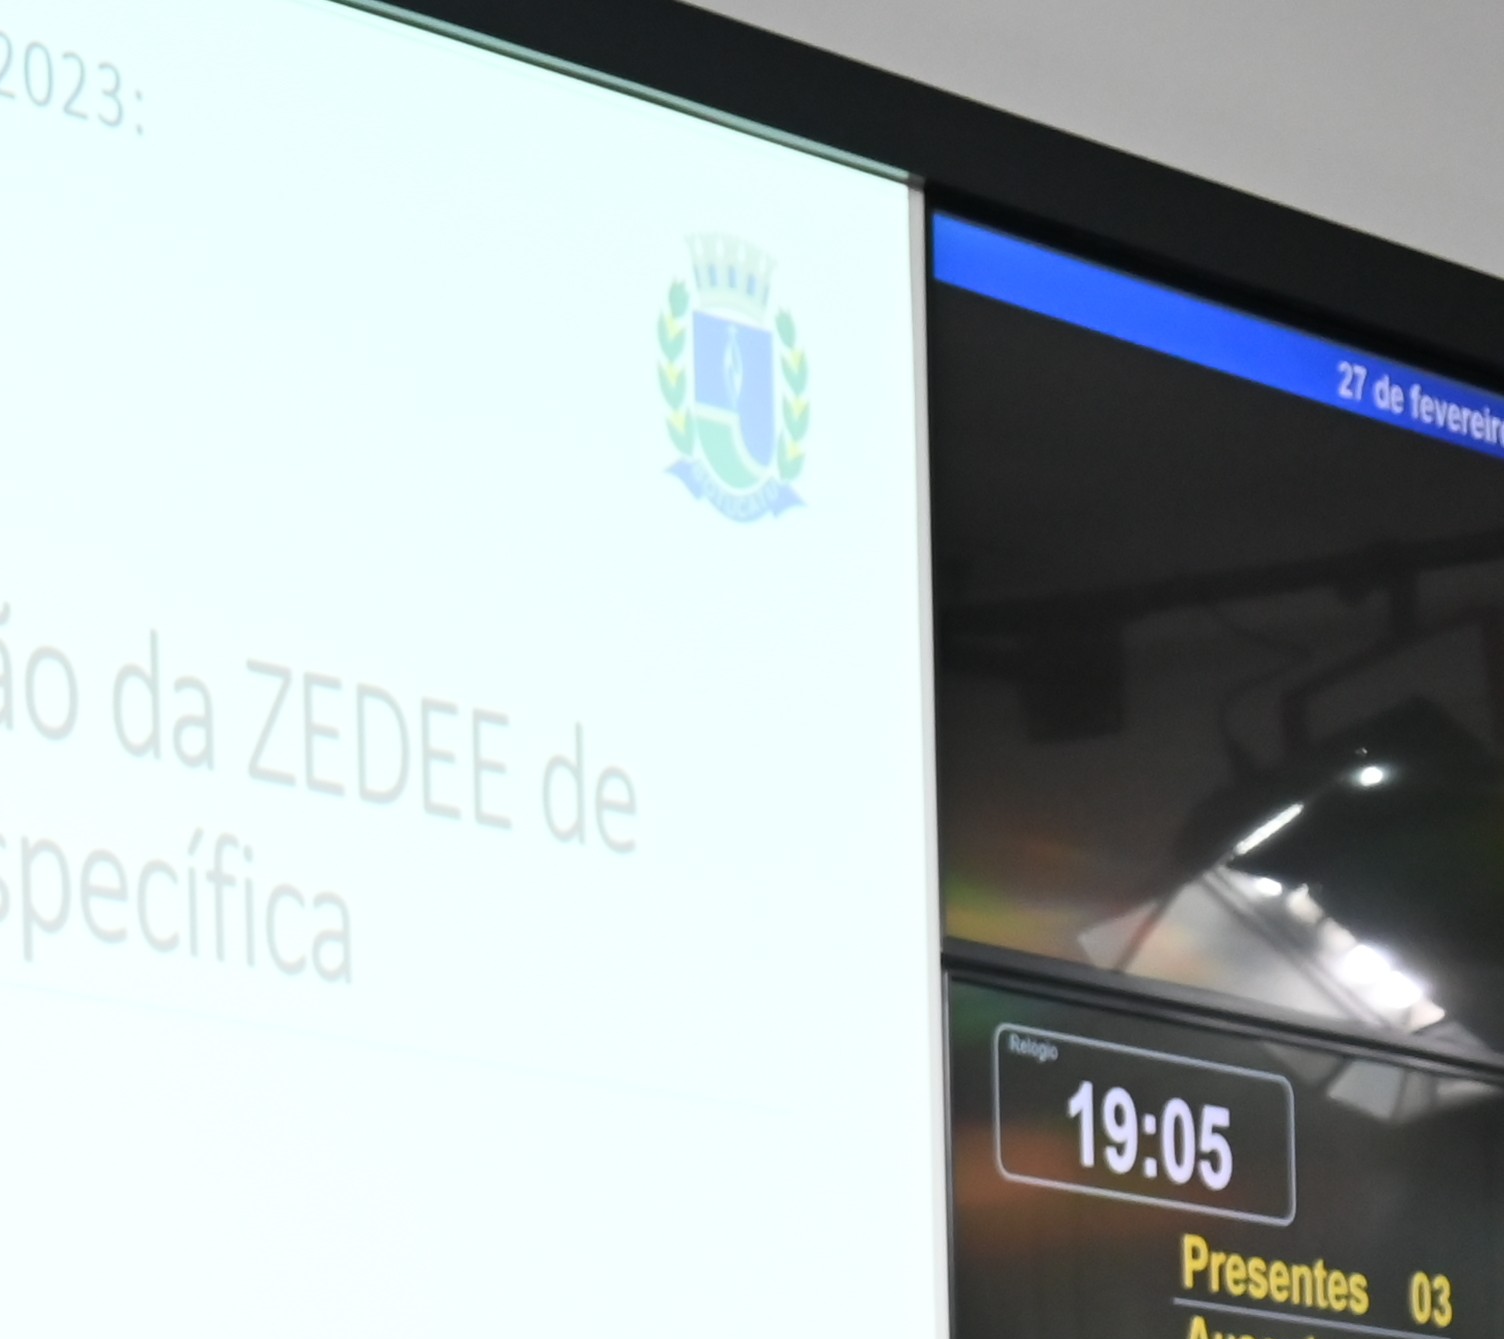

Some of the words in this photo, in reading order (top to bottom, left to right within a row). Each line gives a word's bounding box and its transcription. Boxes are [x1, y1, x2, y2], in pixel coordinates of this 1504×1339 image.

[1338, 362, 1368, 401] 27
[1375, 375, 1404, 414] de
[112, 628, 216, 771] da
[244, 657, 513, 832] ZEDEE
[541, 722, 638, 855] de
[1067, 1080, 1234, 1192] 19:05
[1182, 1234, 1370, 1316] Presentes
[1411, 1272, 1453, 1328] 03
